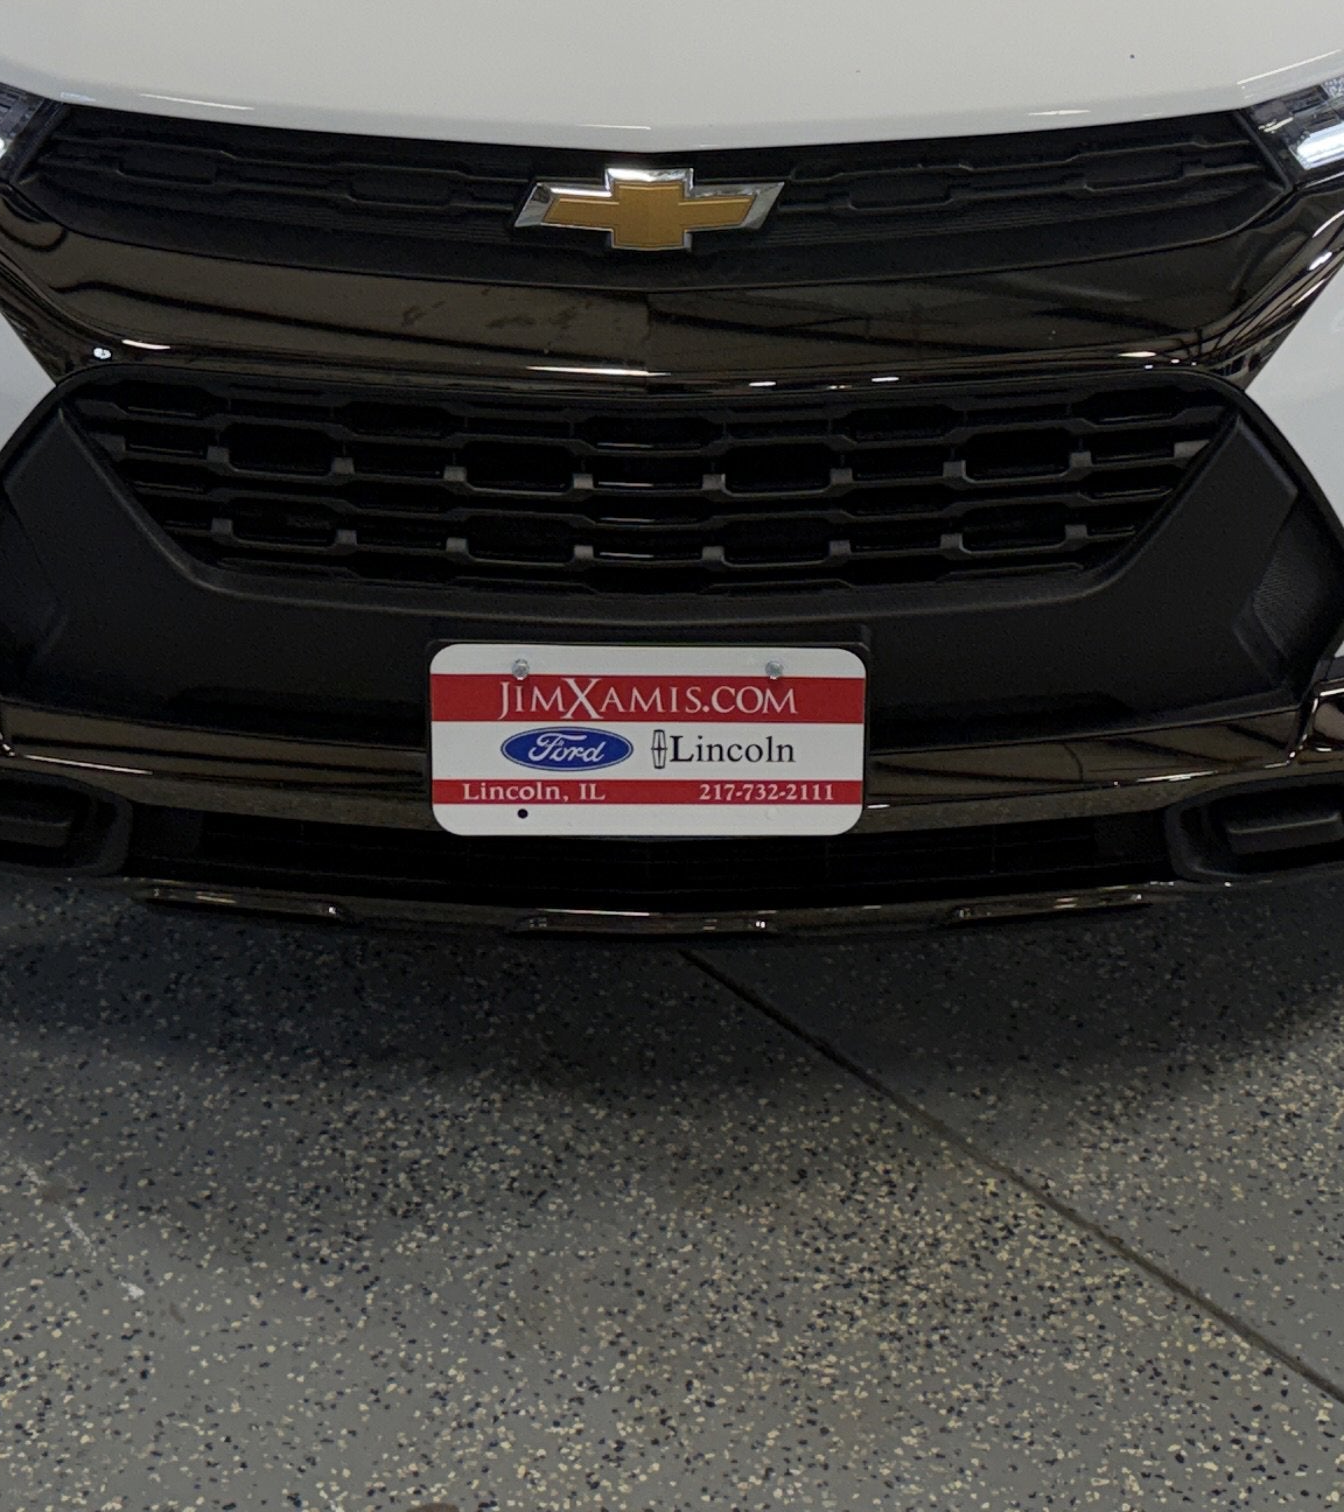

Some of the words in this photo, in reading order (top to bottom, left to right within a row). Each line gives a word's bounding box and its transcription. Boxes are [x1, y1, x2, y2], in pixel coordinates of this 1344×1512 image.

[497, 677, 799, 720] JIMXAMIS.COM
[527, 732, 605, 765] Ford
[669, 734, 797, 764] Lincoln
[463, 782, 569, 803] Lincoln,
[579, 783, 607, 801] IL
[699, 783, 834, 801] 217-732-2111
